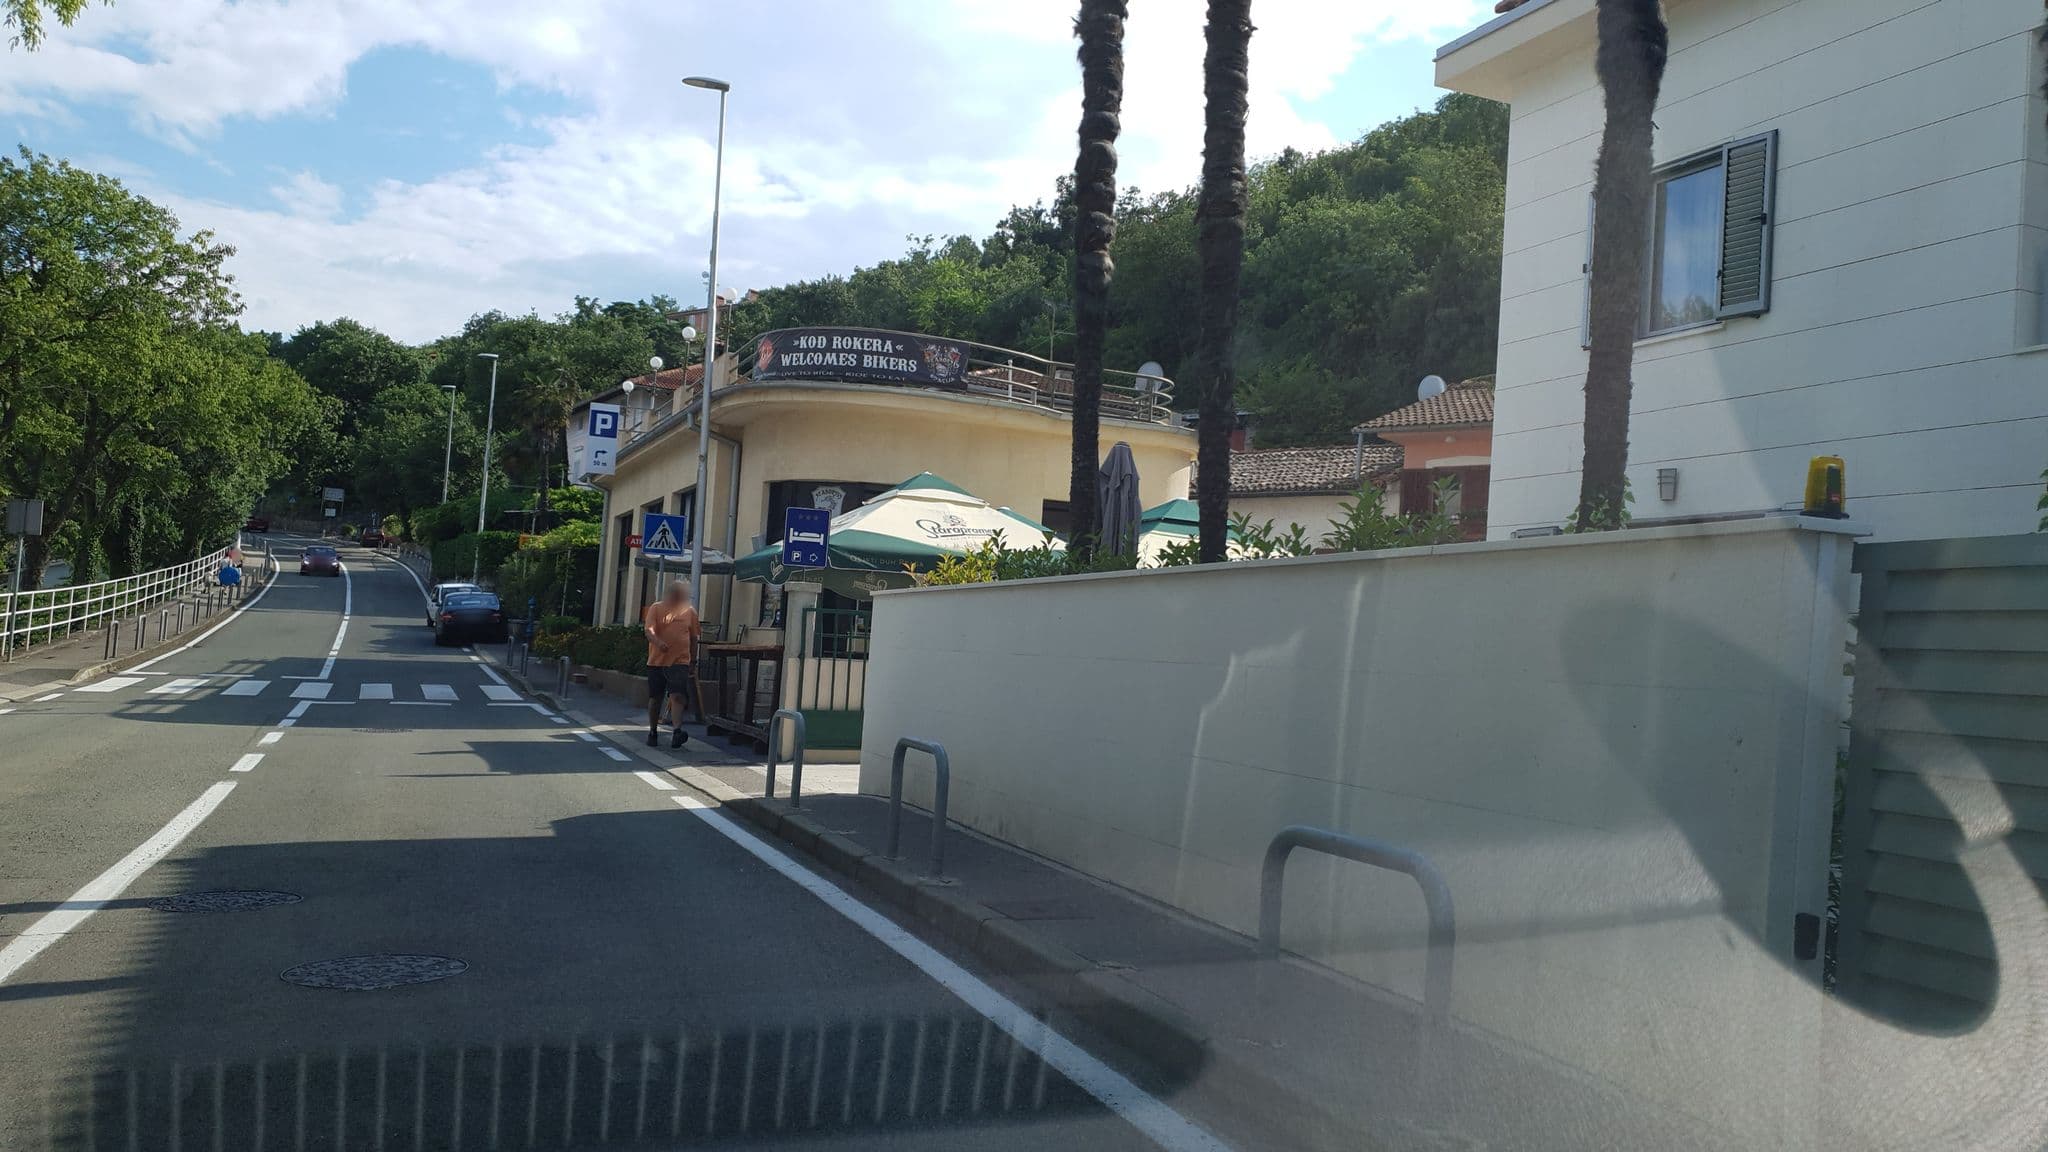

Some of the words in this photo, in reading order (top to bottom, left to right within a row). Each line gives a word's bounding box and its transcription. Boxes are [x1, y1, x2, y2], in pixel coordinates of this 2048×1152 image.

[781, 352, 857, 367] WELCOMES
[863, 354, 917, 373] BIKERS
[595, 413, 613, 435] P
[915, 519, 993, 538] Staroprame
[793, 552, 800, 561] P
